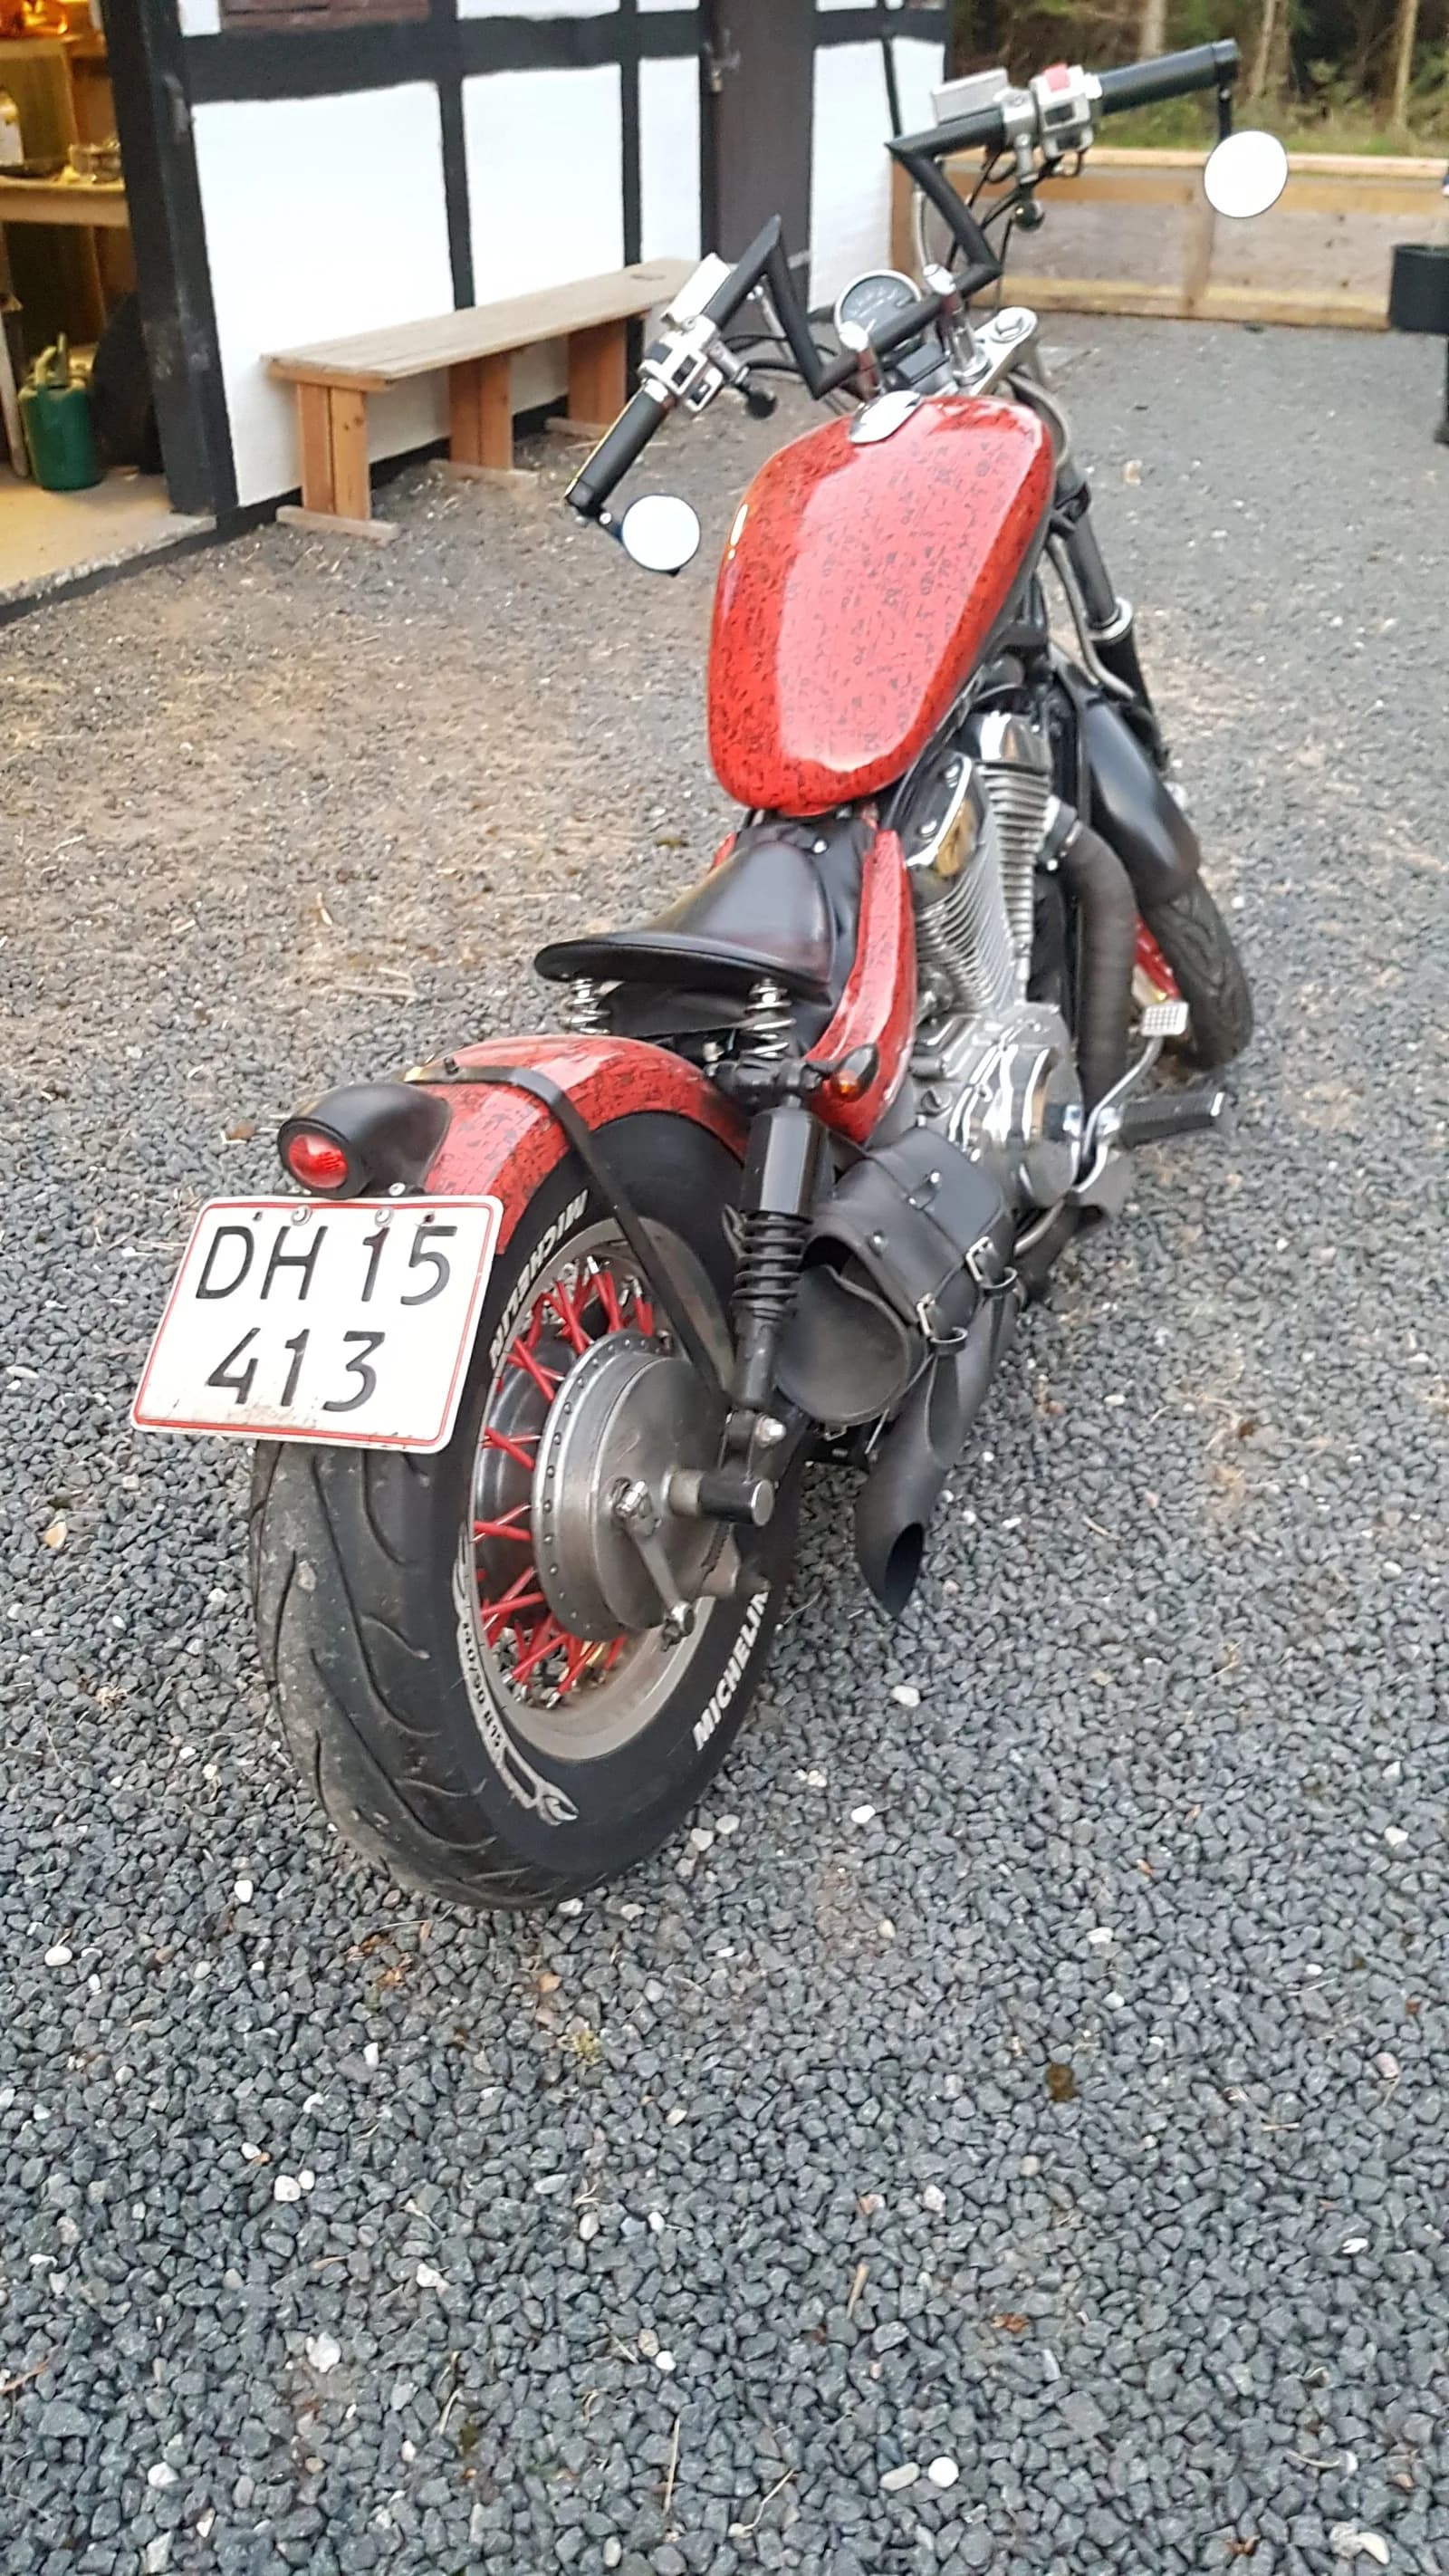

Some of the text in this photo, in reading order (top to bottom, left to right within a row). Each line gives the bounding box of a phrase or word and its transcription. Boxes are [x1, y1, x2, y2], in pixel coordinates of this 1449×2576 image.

[196, 1226, 457, 1305] DH 15
[489, 1188, 589, 1370] MICHELIN
[206, 1327, 386, 1412] 413
[692, 1591, 770, 1752] MICHELIN
